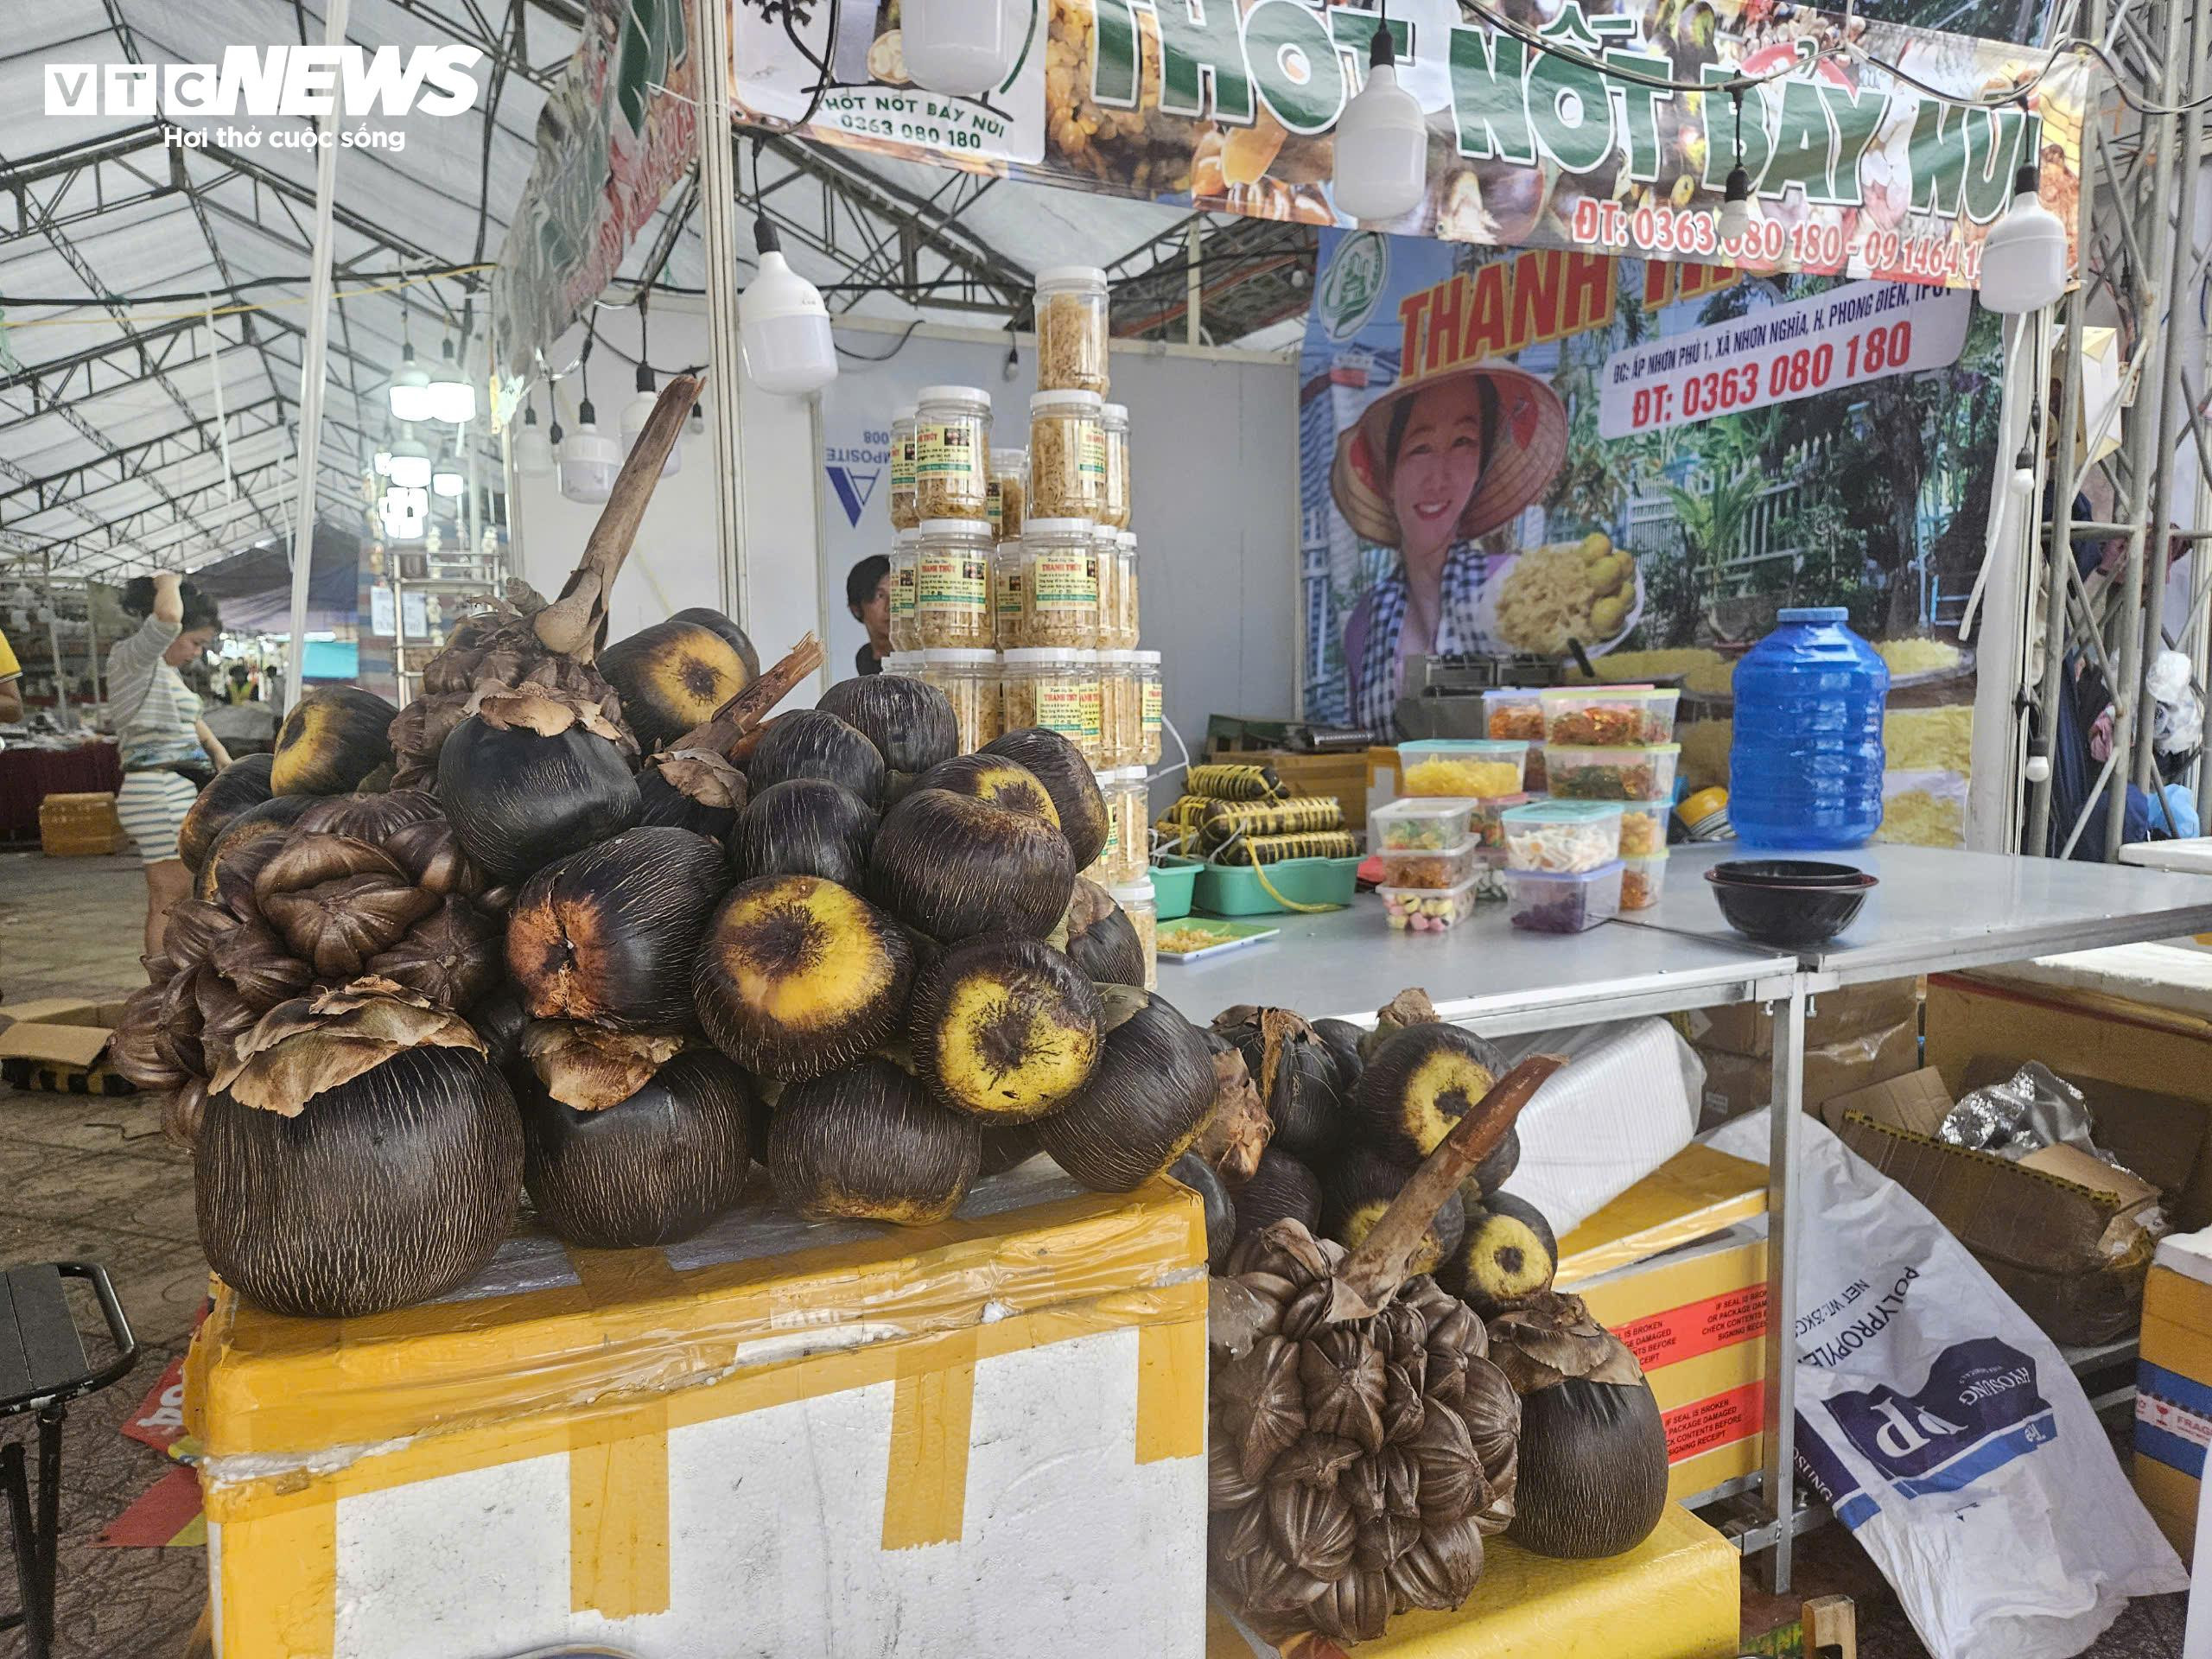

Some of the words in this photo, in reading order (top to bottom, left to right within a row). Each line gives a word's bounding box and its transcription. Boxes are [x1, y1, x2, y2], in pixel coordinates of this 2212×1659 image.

[901, 124, 939, 143] 080
[948, 130, 981, 149] 180
[1572, 199, 1626, 248] ĐT:
[1790, 223, 1842, 265] 180
[1398, 249, 1617, 385] THANH
[1813, 308, 1825, 331] H.
[1829, 293, 1873, 327] PHONG
[1631, 384, 1675, 428] ĐT:
[1682, 362, 1759, 416] 0363
[1769, 343, 1834, 397] 080
[1847, 321, 1912, 378] 180
[1841, 1278, 1871, 1304] NET
[1702, 1323, 1725, 1335] CHECK
[1726, 1311, 1763, 1328] CONTENTS
[1707, 1313, 1718, 1324] OR
[1719, 1304, 1751, 1321] PACKAGE
[1796, 1265, 1921, 1367] POLYPROPYLE
[1633, 1321, 1663, 1336] BROKEN
[1636, 1328, 1672, 1345] DAMAGED
[1718, 1326, 1745, 1341] SIGNING
[1648, 1337, 1677, 1352] BEFORE
[1669, 1417, 1701, 1434] PACKAGE
[1703, 1406, 1737, 1423] DAMAGED
[1674, 1413, 1690, 1425] SEAL
[1692, 1409, 1700, 1418] IS
[1700, 1399, 1729, 1414] BROKEN
[1676, 1425, 1713, 1443] CONTENTS
[1714, 1414, 1743, 1430] BEFORE
[1697, 1430, 1726, 1446] RECEIPT
